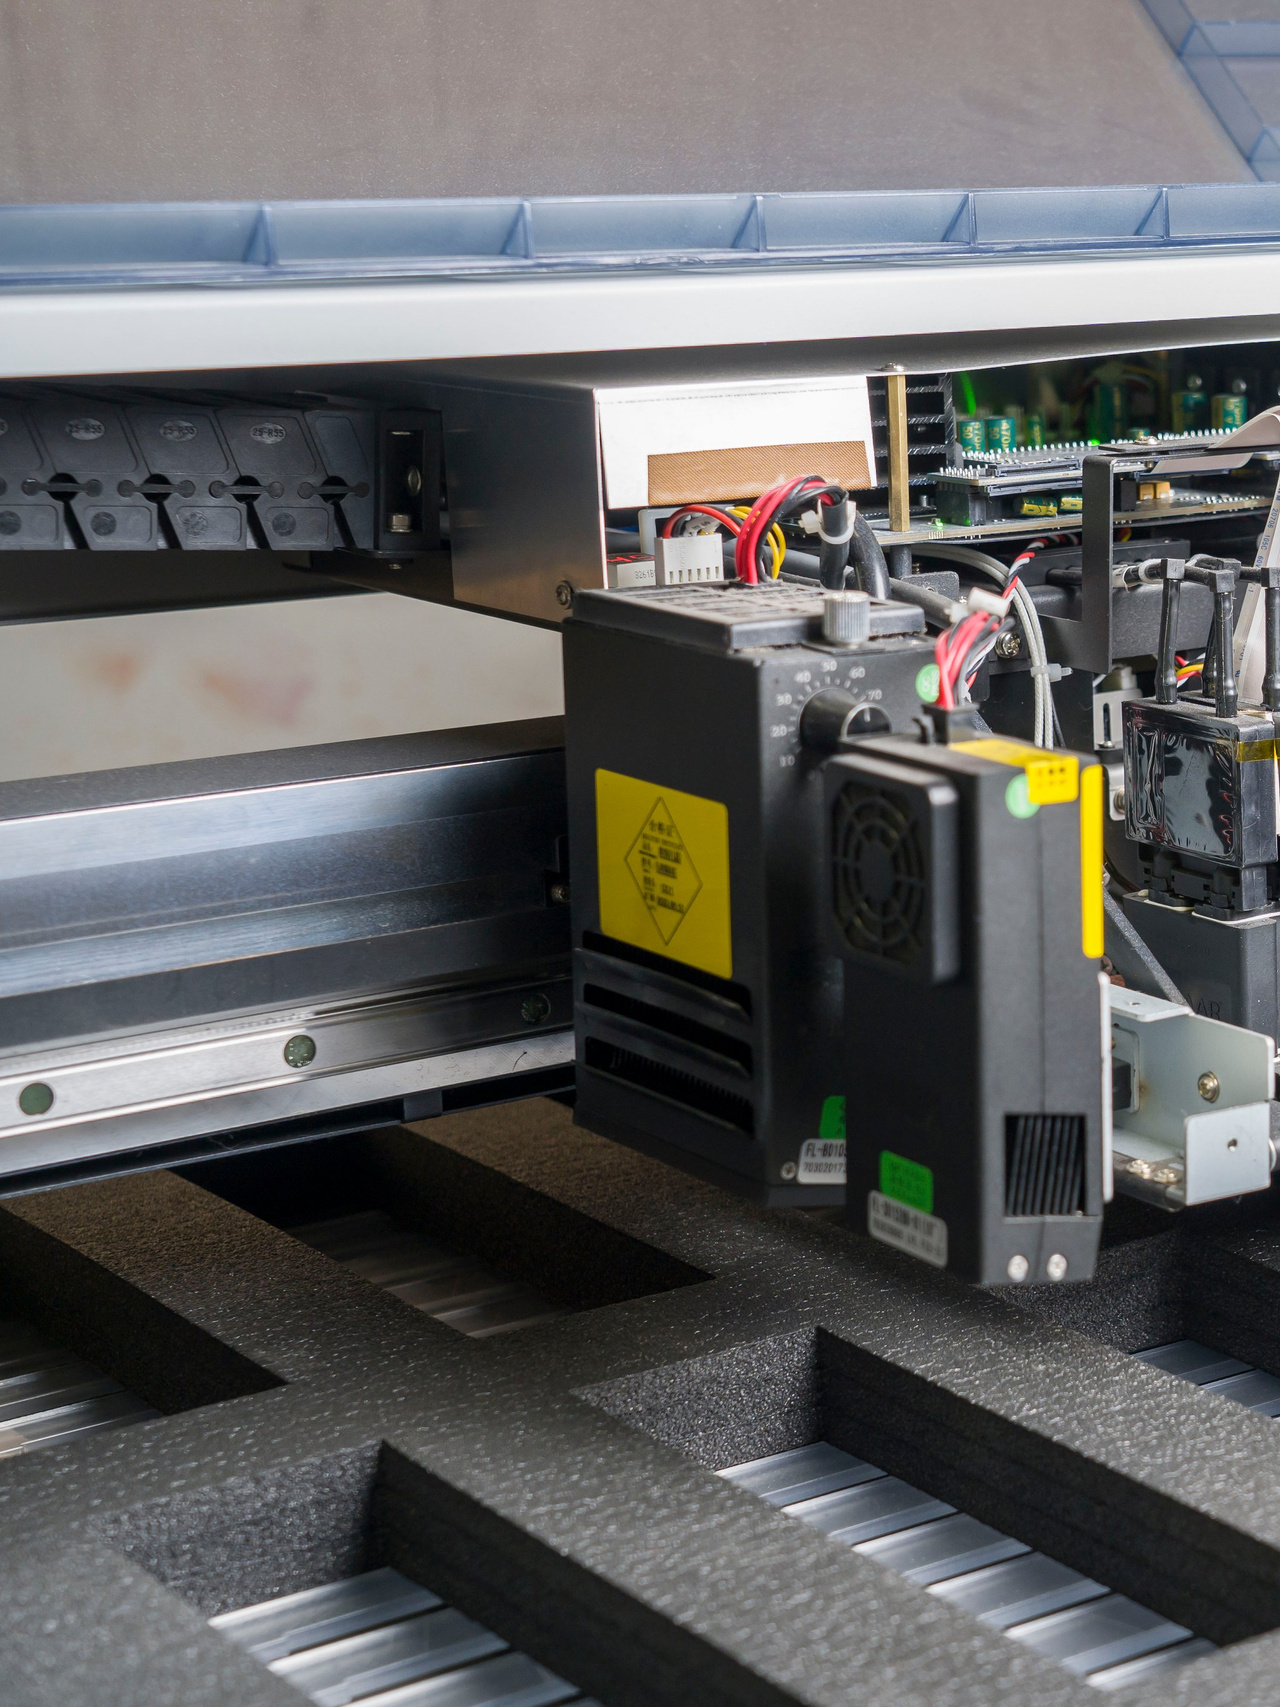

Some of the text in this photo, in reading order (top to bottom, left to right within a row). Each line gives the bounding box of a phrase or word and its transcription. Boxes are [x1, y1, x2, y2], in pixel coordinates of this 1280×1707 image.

[162, 425, 195, 436] 25-R55
[252, 427, 284, 438] 25-R55
[1267, 508, 1279, 529] 20706
[1260, 534, 1271, 551] 105C
[820, 660, 837, 673] 50
[849, 665, 866, 680] 60
[794, 670, 811, 684] 40
[775, 692, 792, 707] 30
[866, 687, 883, 701] 70
[770, 723, 788, 739] 20
[780, 753, 796, 768] 10
